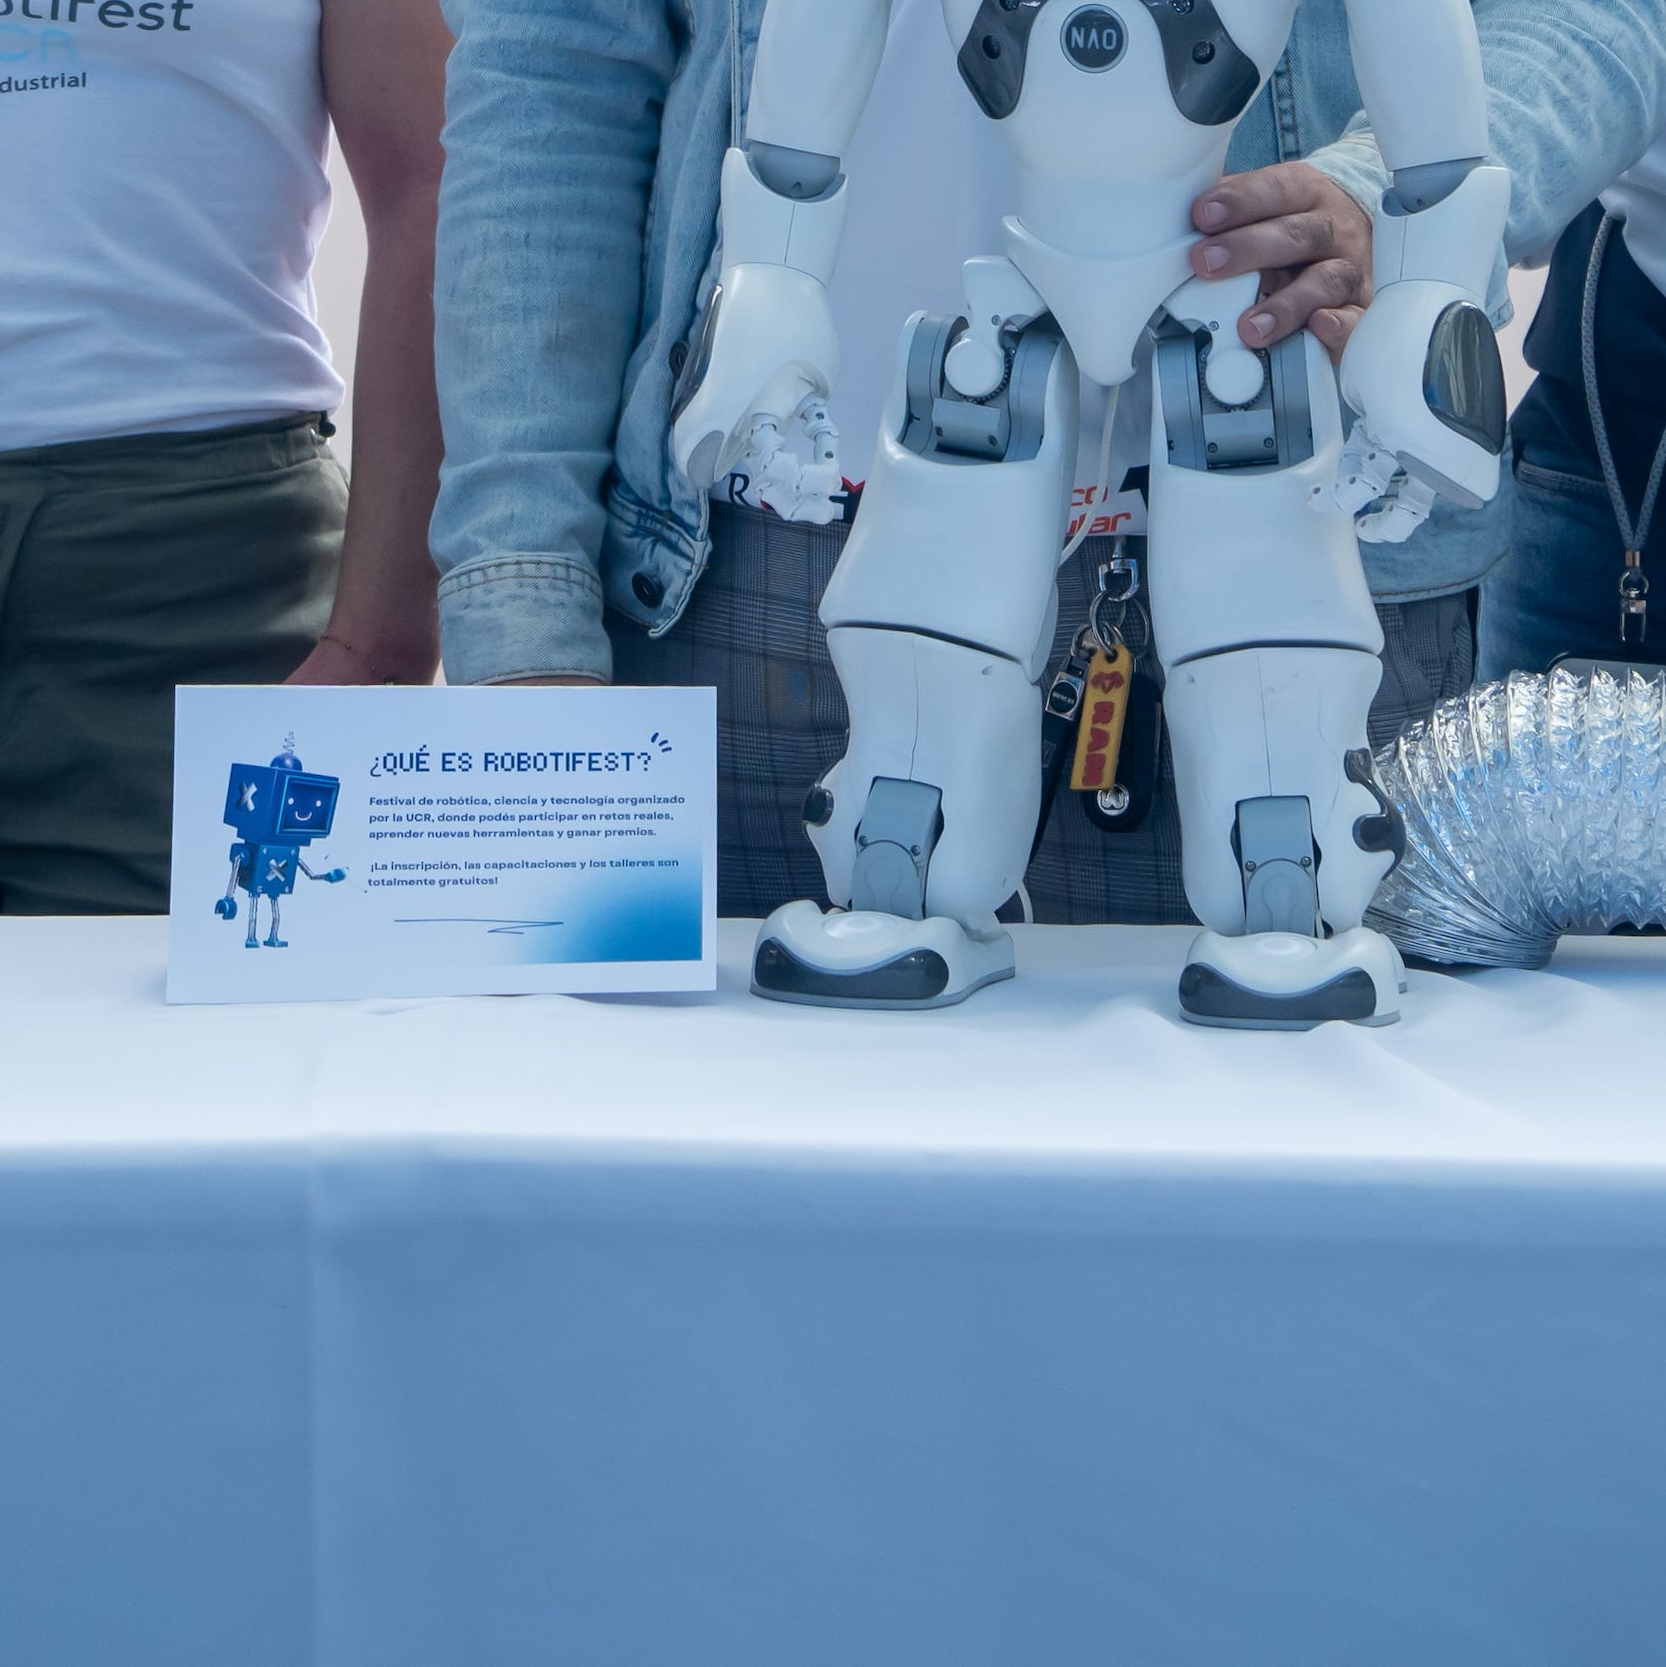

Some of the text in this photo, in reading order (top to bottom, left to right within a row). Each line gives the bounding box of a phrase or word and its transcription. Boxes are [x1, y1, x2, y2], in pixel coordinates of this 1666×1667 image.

[1071, 27, 1117, 50] NAO
[370, 744, 651, 777] ¿QUÉ ES ROBOTIFEST?
[369, 795, 685, 806] Festival de robótica, ciencia y tecnología organizado
[369, 814, 390, 824] por
[393, 813, 403, 822] la
[406, 813, 435, 822] UCR,
[437, 813, 476, 822] donde
[479, 812, 516, 822] podés
[518, 812, 579, 822] participar
[599, 812, 631, 821] retos
[634, 812, 674, 821] reales,
[369, 827, 657, 840] aprender nuevas herramientas y ganar premios.
[391, 861, 461, 871] inscripción,
[464, 861, 481, 869] las
[483, 860, 577, 870] capacitaciones
[609, 859, 655, 867] talleres
[368, 876, 498, 887] totalmente gratuitos!
